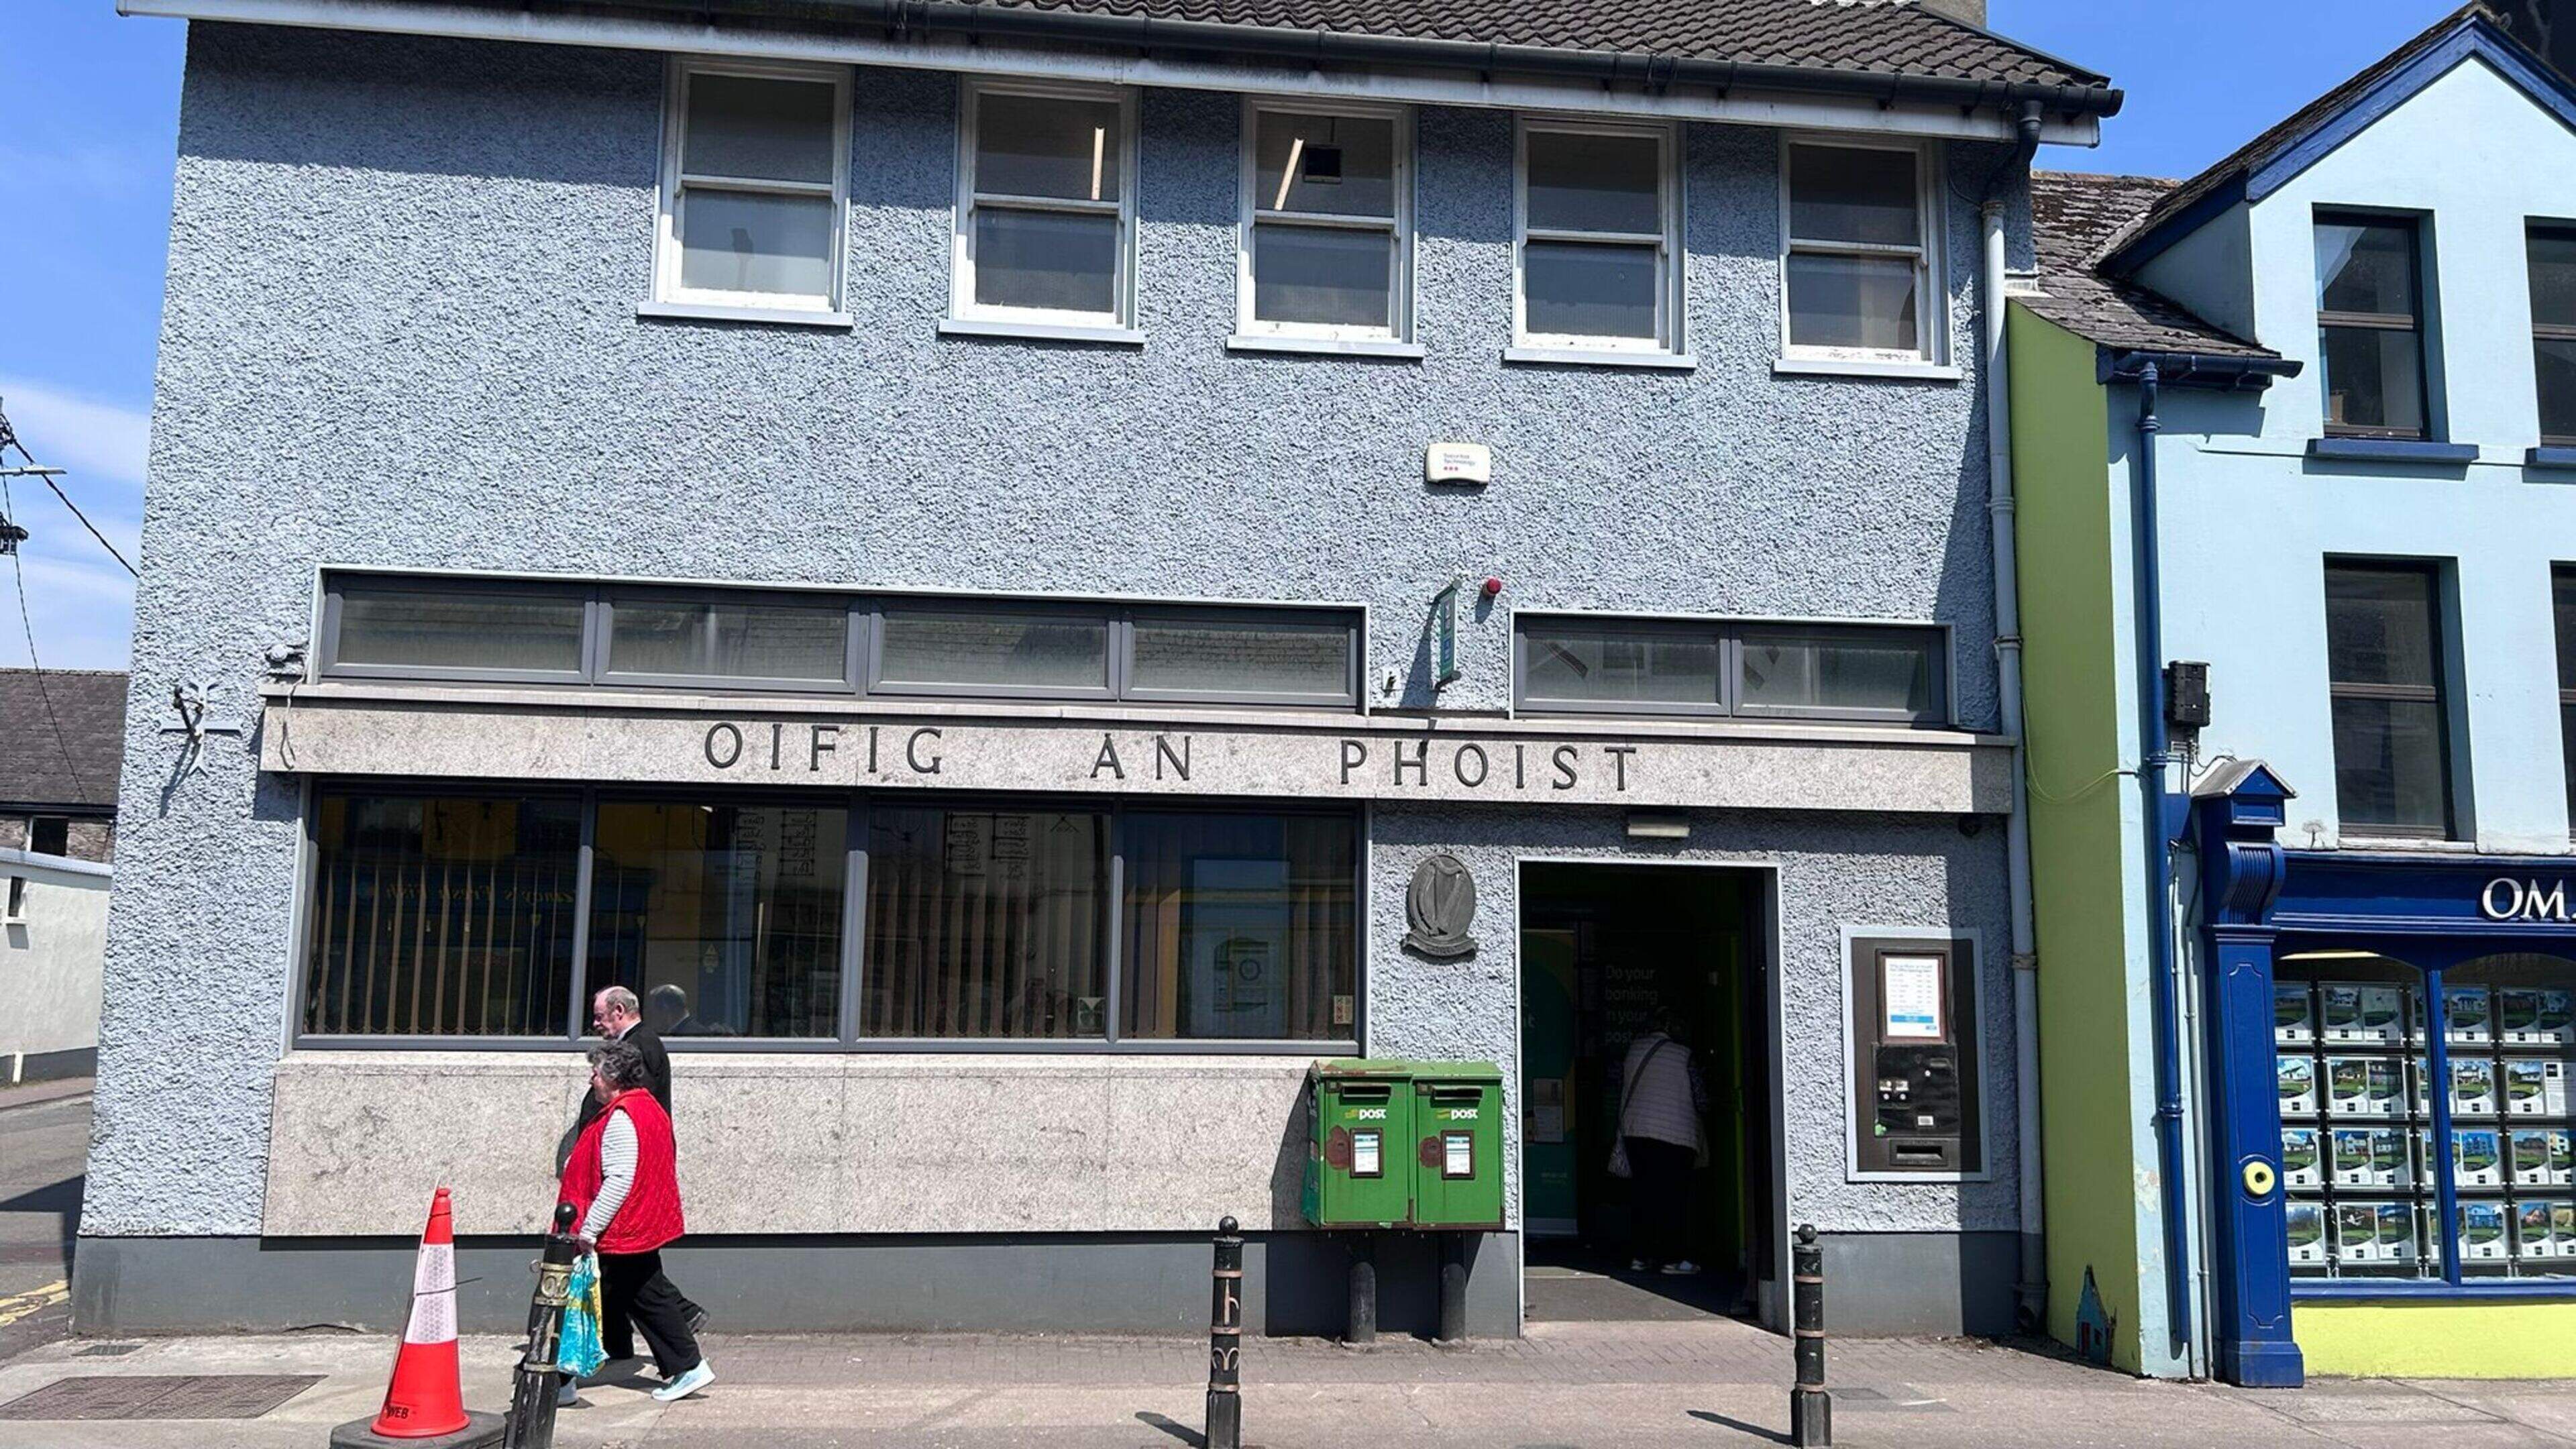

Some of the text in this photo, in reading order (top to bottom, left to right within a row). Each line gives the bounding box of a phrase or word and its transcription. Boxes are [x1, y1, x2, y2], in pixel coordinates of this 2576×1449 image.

[704, 722, 1637, 792] OIFIG AN PHOIST
[2482, 877, 2576, 920] OM
[1605, 966, 1656, 982] Do your
[1605, 985, 1658, 1005] banking
[1359, 1109, 1387, 1120] post
[1451, 1109, 1479, 1120] post
